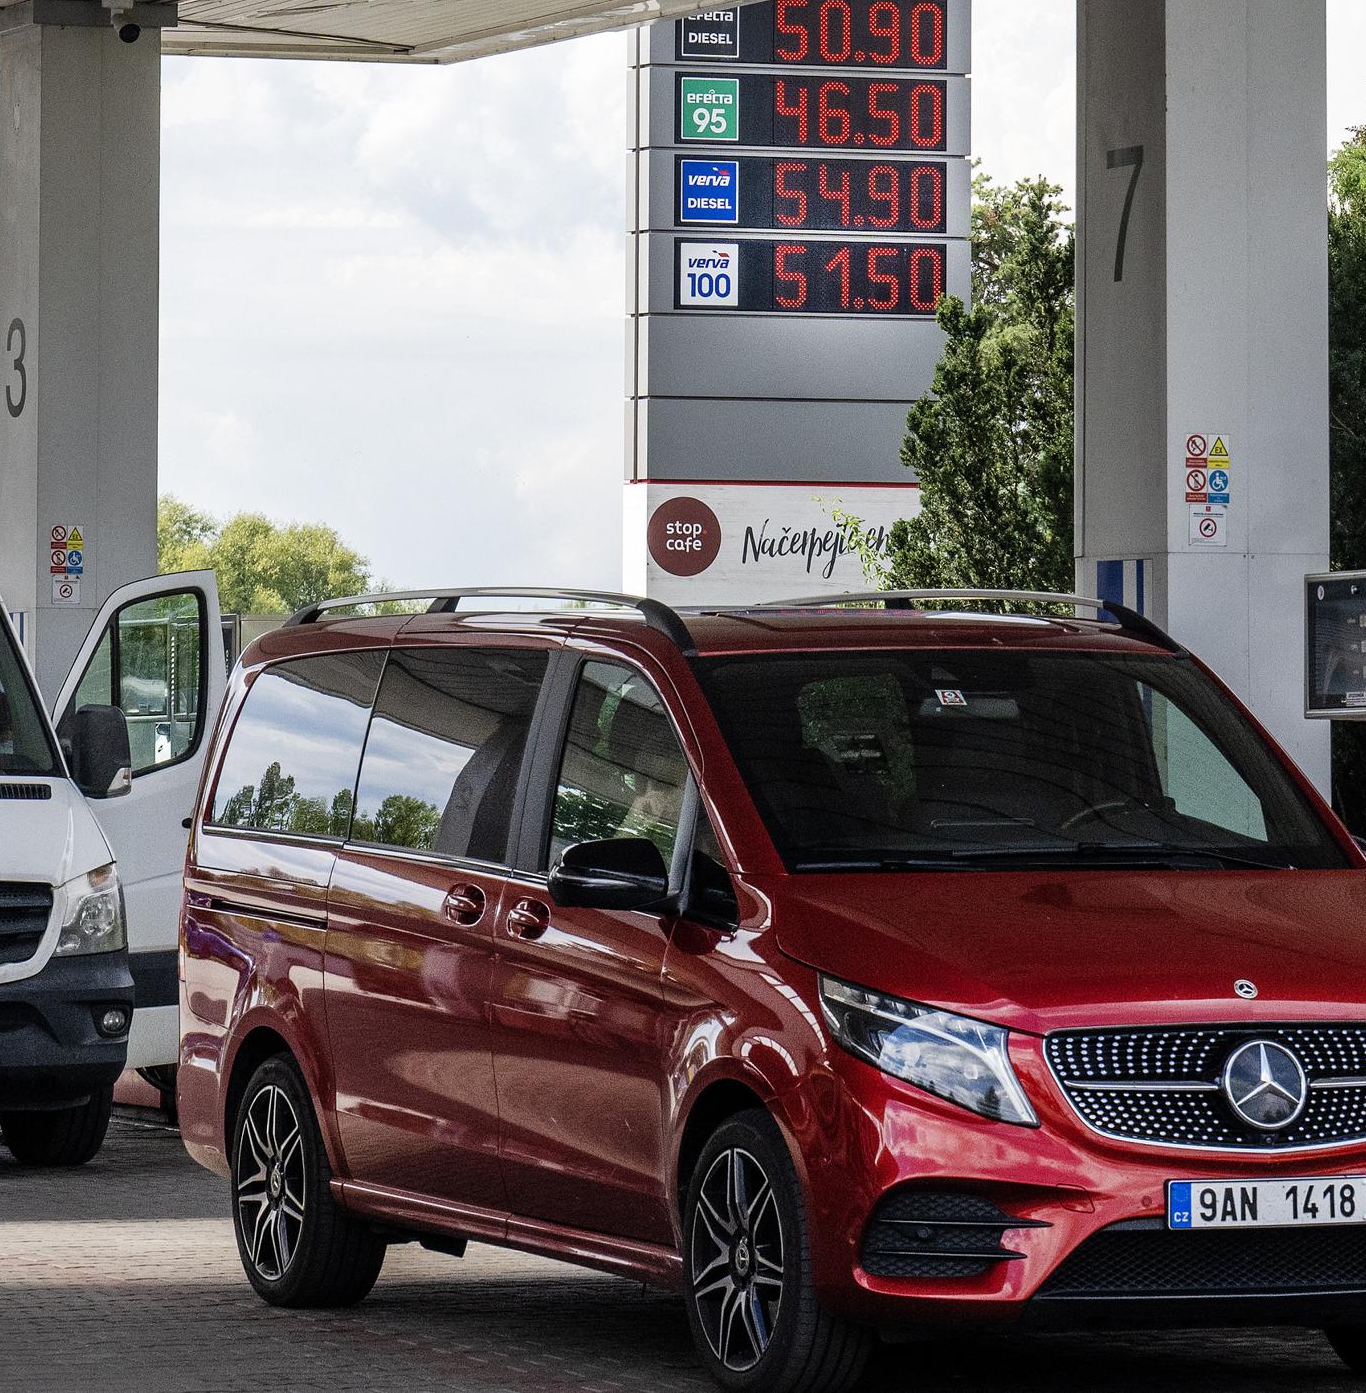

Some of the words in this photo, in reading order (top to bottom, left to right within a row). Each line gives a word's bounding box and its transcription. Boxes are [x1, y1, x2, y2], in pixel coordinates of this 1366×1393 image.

[688, 32, 733, 45] DIESEL
[687, 90, 733, 104] efecta
[692, 108, 727, 134] 95
[775, 80, 942, 147] 46.50
[688, 171, 731, 187] verva
[687, 198, 732, 210] DIESEL
[775, 162, 941, 229] 54.90
[1106, 144, 1145, 283] 7
[688, 255, 730, 269] verva
[687, 273, 731, 298] 100
[775, 244, 941, 311] 51.50
[5, 317, 26, 418] 3
[666, 537, 702, 553] cafe
[1173, 1212, 1189, 1222] CZ
[1199, 1186, 1258, 1222] 9AN
[1285, 1183, 1356, 1220] 1418
